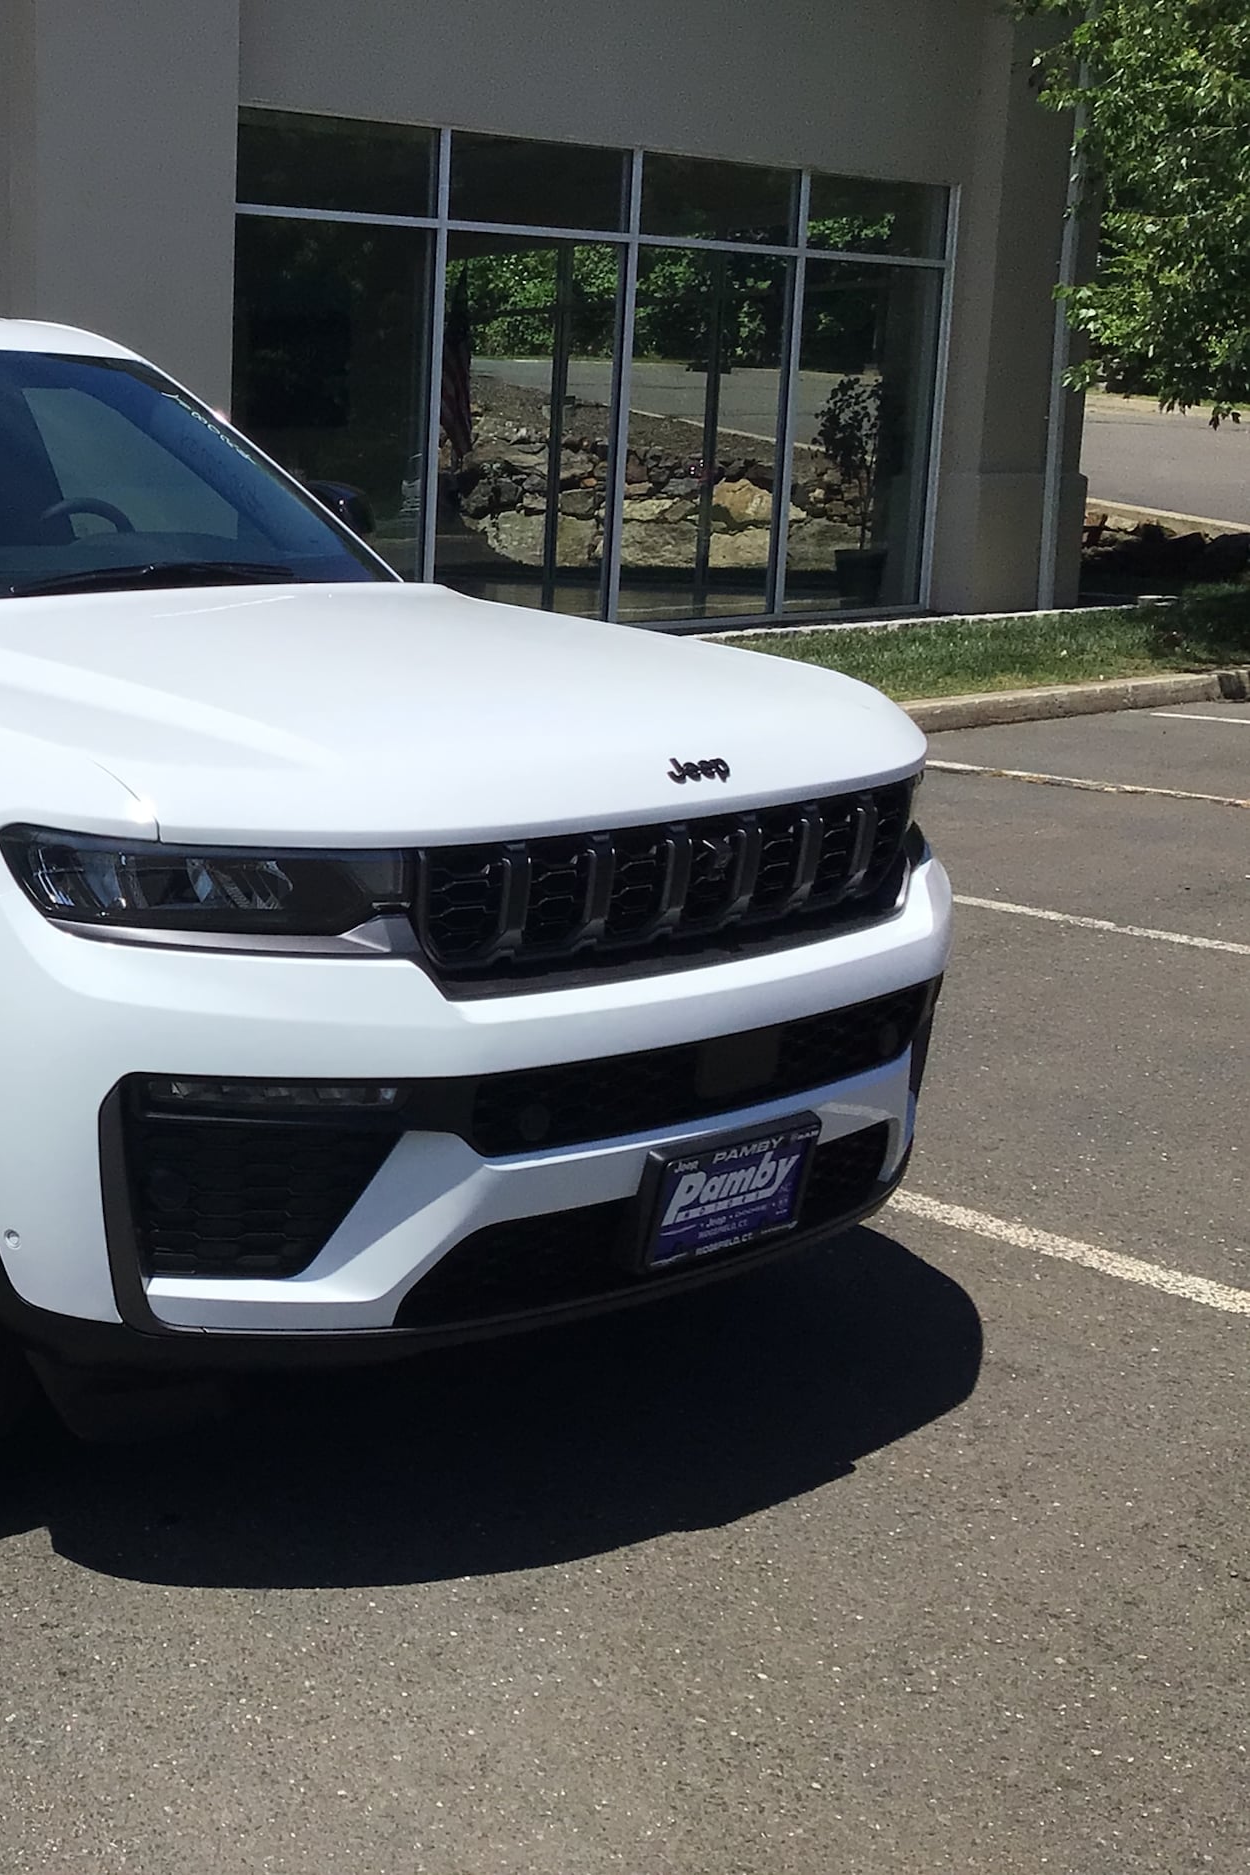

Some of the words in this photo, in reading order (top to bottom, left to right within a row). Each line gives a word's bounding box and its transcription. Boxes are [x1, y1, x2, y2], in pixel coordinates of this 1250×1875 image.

[667, 757, 731, 785] Jeep
[712, 1136, 784, 1164] PAMBY
[661, 1151, 800, 1227] Pamby
